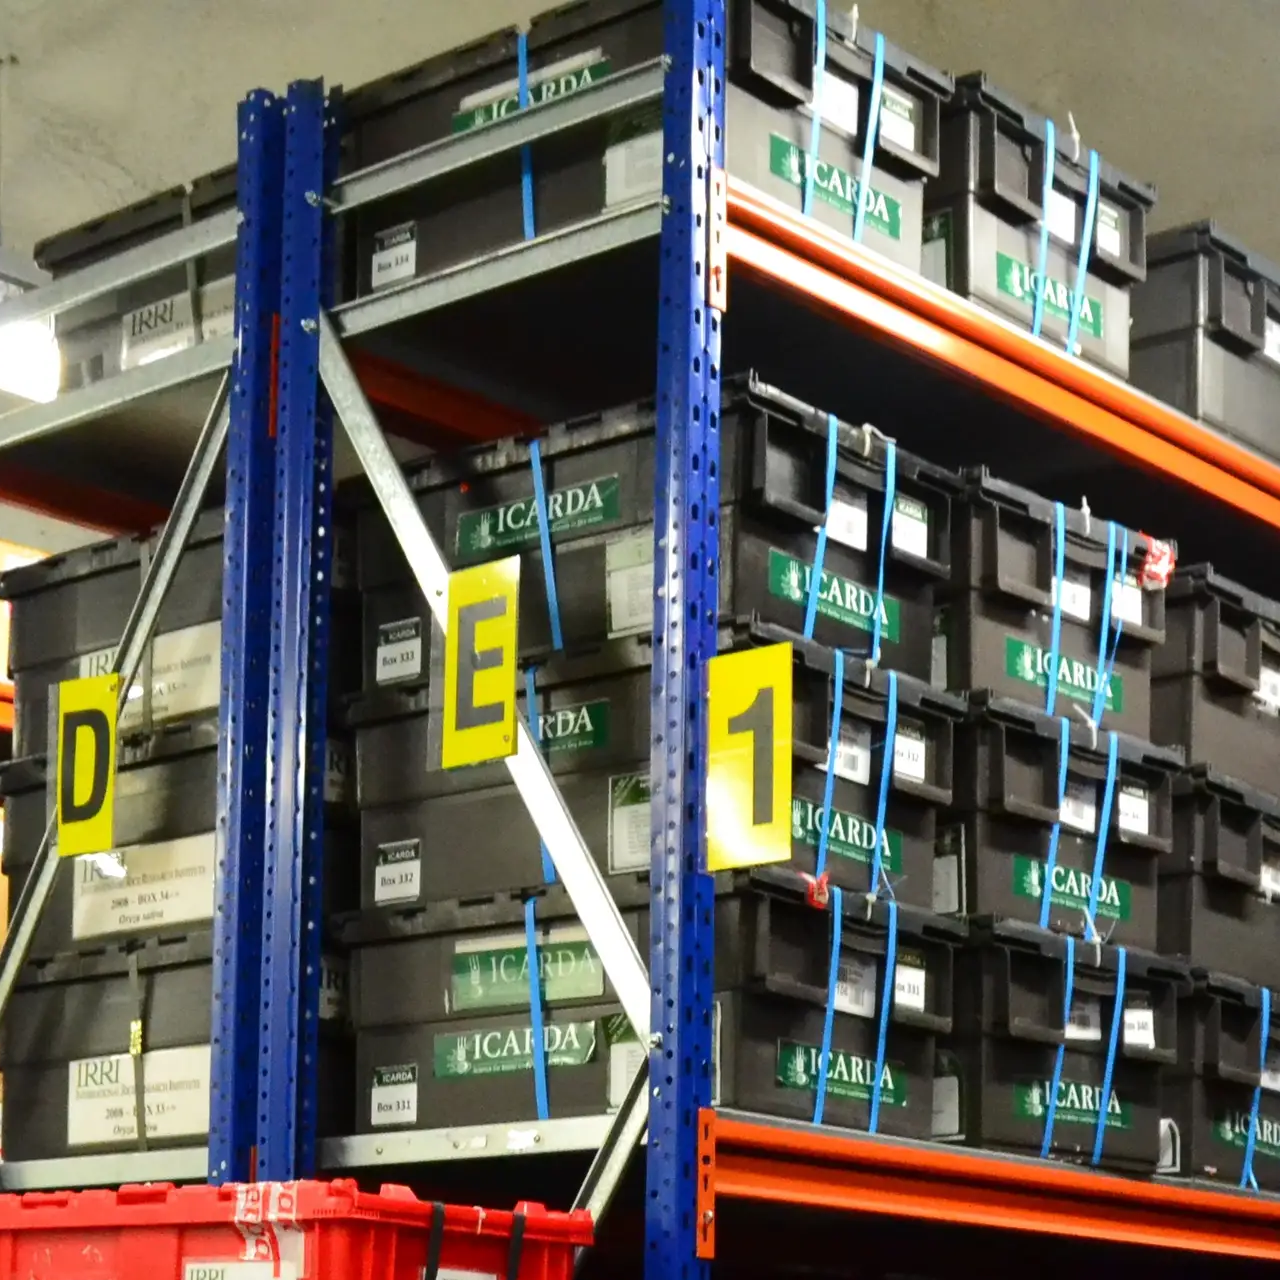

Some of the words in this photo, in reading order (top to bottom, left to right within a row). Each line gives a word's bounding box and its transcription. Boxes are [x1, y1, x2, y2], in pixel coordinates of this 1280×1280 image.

[1023, 265, 1093, 322] ICARA
[131, 299, 175, 337] IRRI
[496, 481, 604, 535] ICARDA
[805, 564, 888, 625] ICARDA
[381, 653, 398, 667] Box
[455, 596, 508, 731] E
[60, 708, 112, 826] D
[728, 686, 774, 827] 1
[380, 873, 397, 888] Box
[472, 1022, 582, 1061] ICARDA
[77, 1057, 120, 1088] IRRI
[808, 1049, 896, 1091] ICARDA
[377, 1100, 394, 1113] Box
